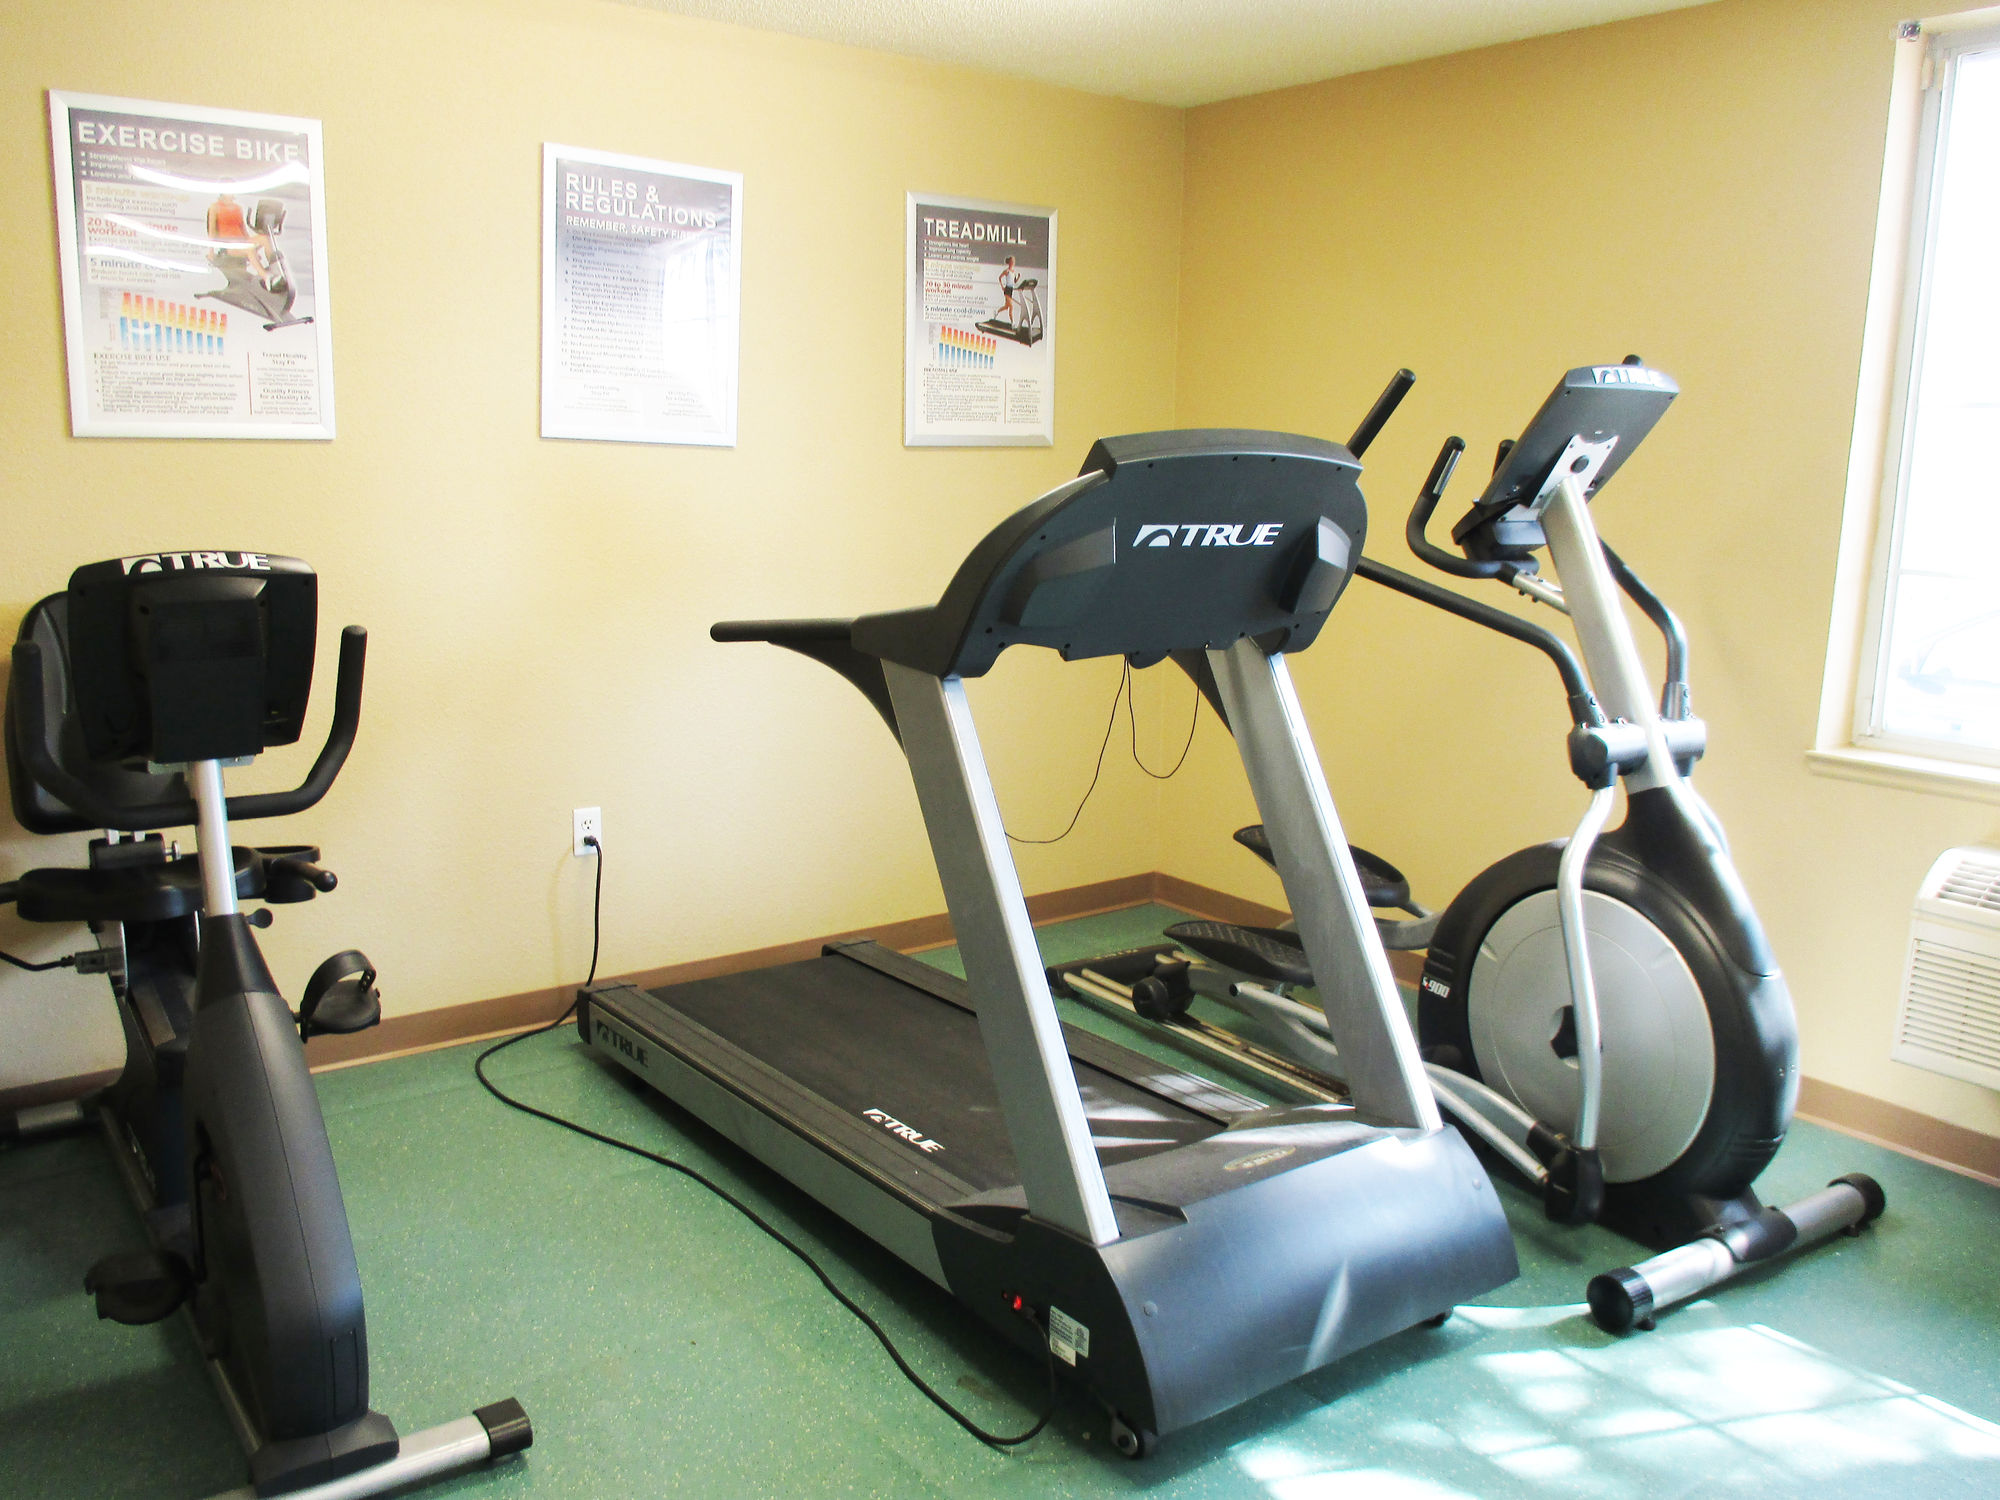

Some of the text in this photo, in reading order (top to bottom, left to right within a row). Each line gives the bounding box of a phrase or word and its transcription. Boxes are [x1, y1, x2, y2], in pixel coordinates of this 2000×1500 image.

[78, 121, 300, 162] EXERCISE BIKE
[566, 172, 660, 204] RULES &
[88, 217, 102, 226] 20
[565, 191, 718, 230] REGULATIONS
[88, 226, 137, 238] workout
[566, 215, 628, 235] REMEMBER,
[630, 224, 669, 240] SAFETY
[924, 218, 1027, 246] TREADMILL
[100, 258, 140, 268] minute
[1180, 523, 1284, 548] TRUE
[162, 552, 271, 571] TRUE
[612, 1031, 649, 1068] TRUE
[884, 1116, 945, 1153] TRUE
